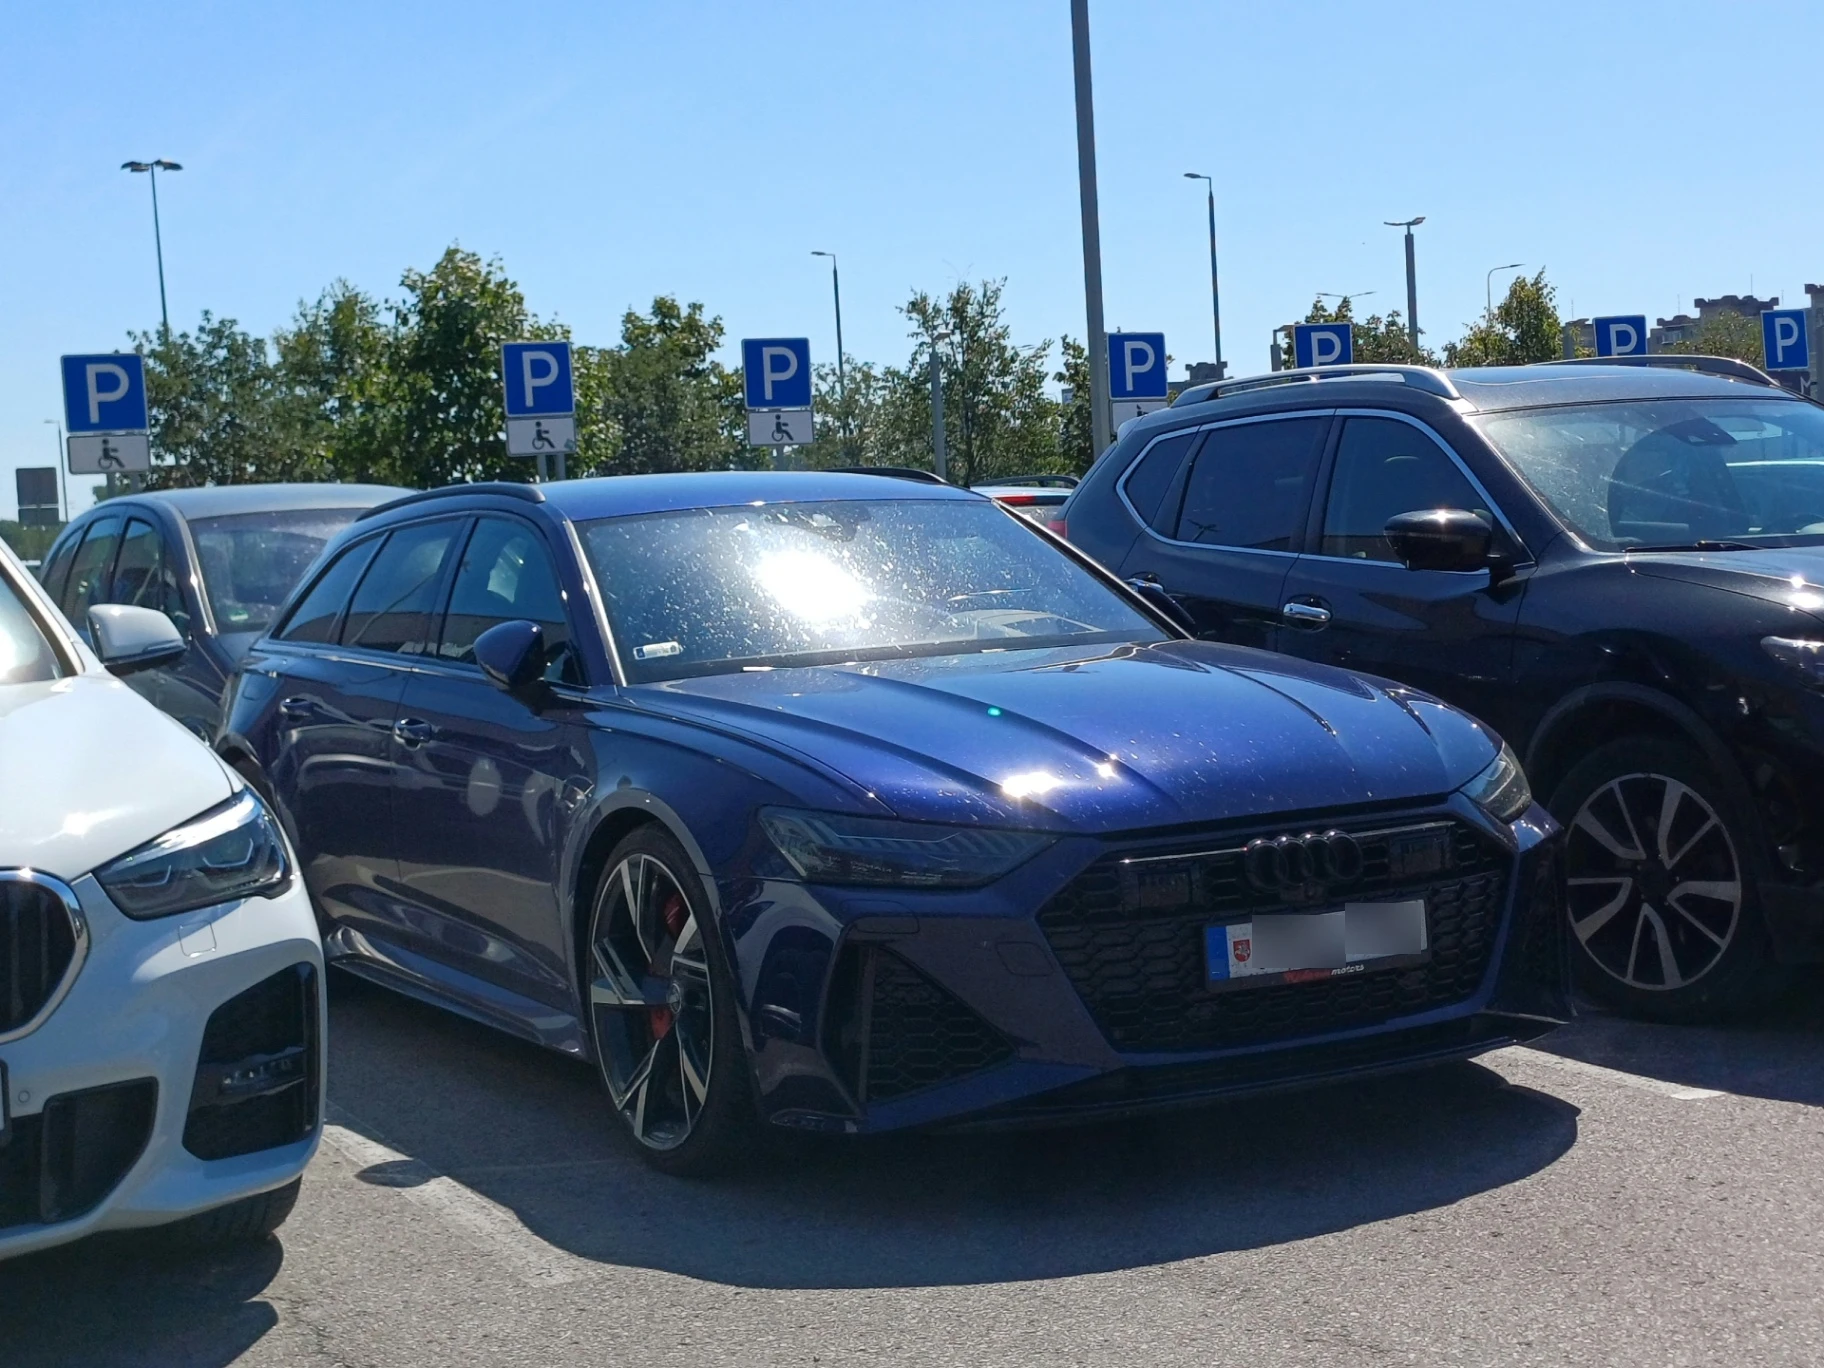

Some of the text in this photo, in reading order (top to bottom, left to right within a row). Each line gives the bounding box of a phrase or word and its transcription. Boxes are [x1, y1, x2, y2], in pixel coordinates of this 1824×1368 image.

[1311, 331, 1341, 366] P
[1609, 323, 1637, 356] P
[1774, 317, 1799, 363] P
[522, 351, 559, 407] P
[762, 346, 798, 400] P
[1124, 341, 1155, 391] P
[86, 363, 130, 424] P
